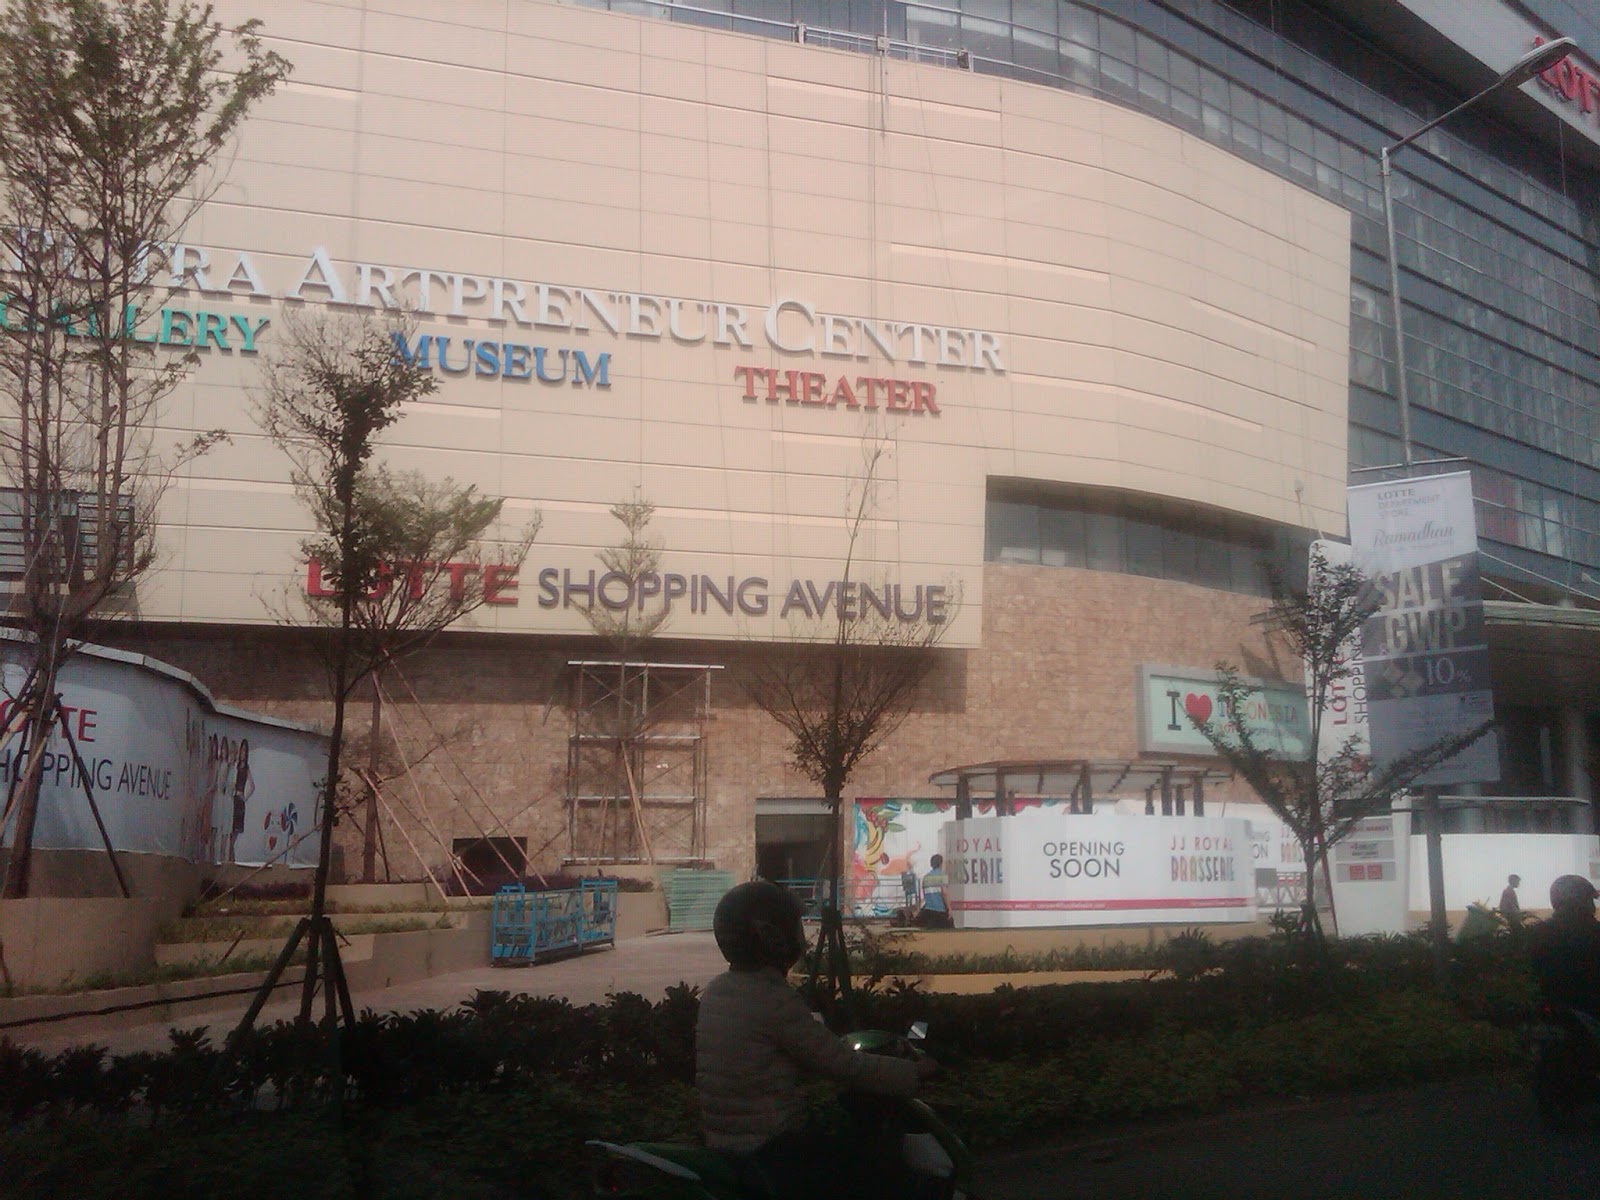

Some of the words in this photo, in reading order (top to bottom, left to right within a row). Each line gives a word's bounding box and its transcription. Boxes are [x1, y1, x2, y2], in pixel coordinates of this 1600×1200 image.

[285, 246, 753, 347] ARTPRENEUR
[764, 299, 1006, 371] CENTER
[391, 322, 612, 387] MUSEUM
[734, 365, 942, 415] THEATER
[1377, 488, 1416, 500] LOTTE
[538, 567, 768, 616] SHOPPING
[780, 579, 946, 626] AVENUE
[1374, 561, 1464, 609] SALE
[117, 762, 172, 800] AVENUE
[1043, 841, 1125, 857] OPENING
[1170, 835, 1185, 851] JJ
[1049, 858, 1120, 879] SOON
